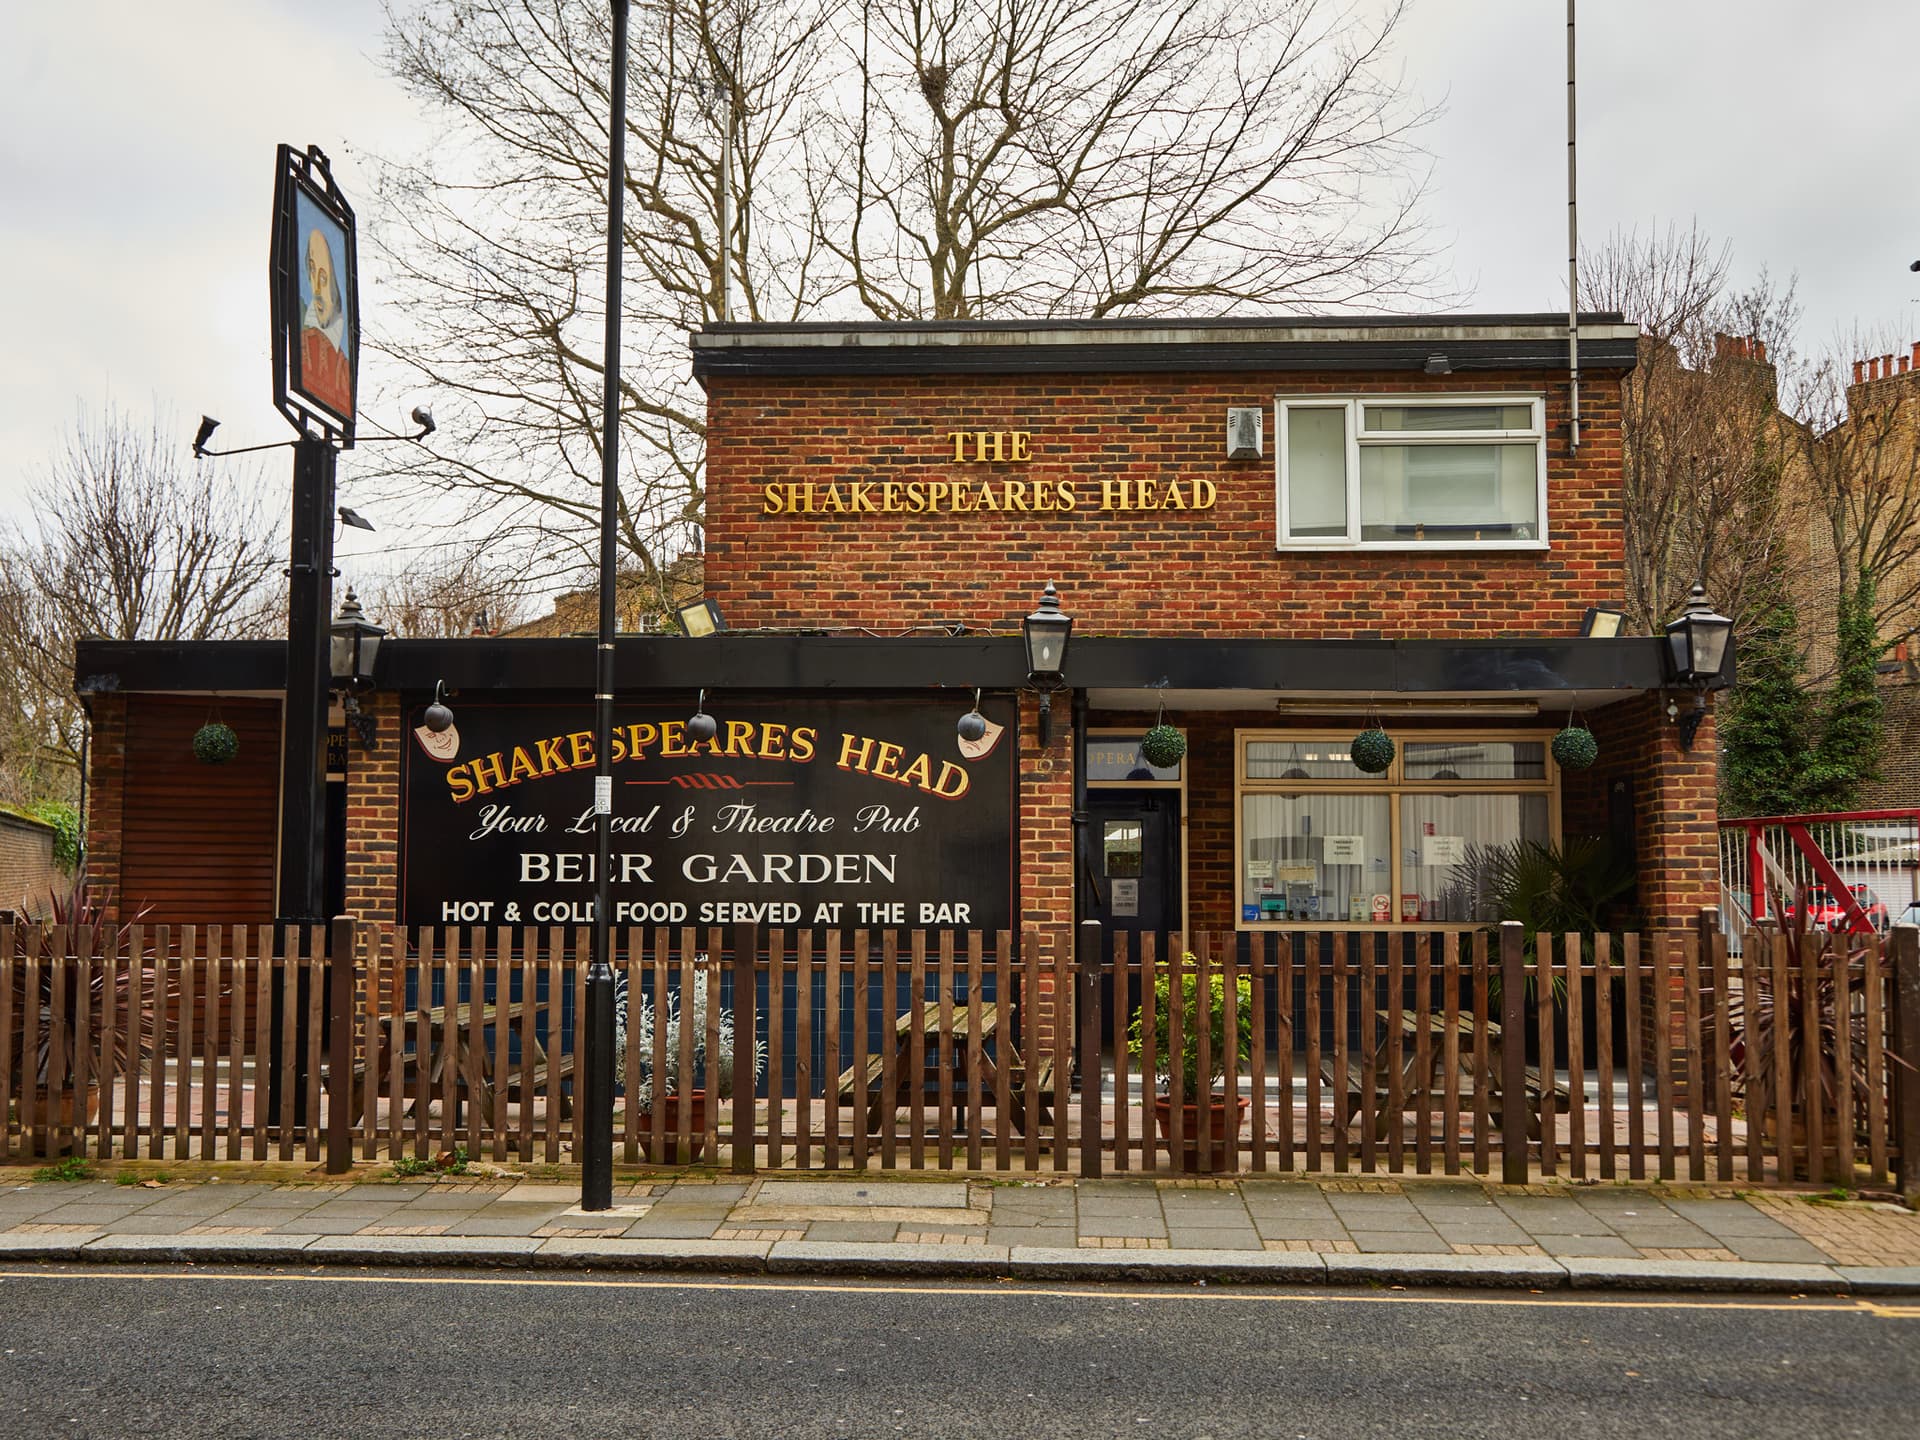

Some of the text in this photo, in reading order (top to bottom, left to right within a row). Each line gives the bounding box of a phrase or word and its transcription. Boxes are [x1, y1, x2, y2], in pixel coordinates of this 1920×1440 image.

[948, 431, 1033, 462] THE
[763, 479, 1217, 514] SHAKESPEARES HEAD
[835, 732, 971, 801] HEAD
[469, 803, 922, 841] Your Lcal & Theatre Pub
[681, 853, 897, 884] GARDEN
[442, 901, 494, 922] HOT
[504, 902, 522, 922] &
[616, 902, 688, 923] FOOD
[699, 902, 801, 924] SERVED
[813, 902, 844, 924] AT
[857, 902, 905, 924] THE
[919, 902, 972, 924] BAR
